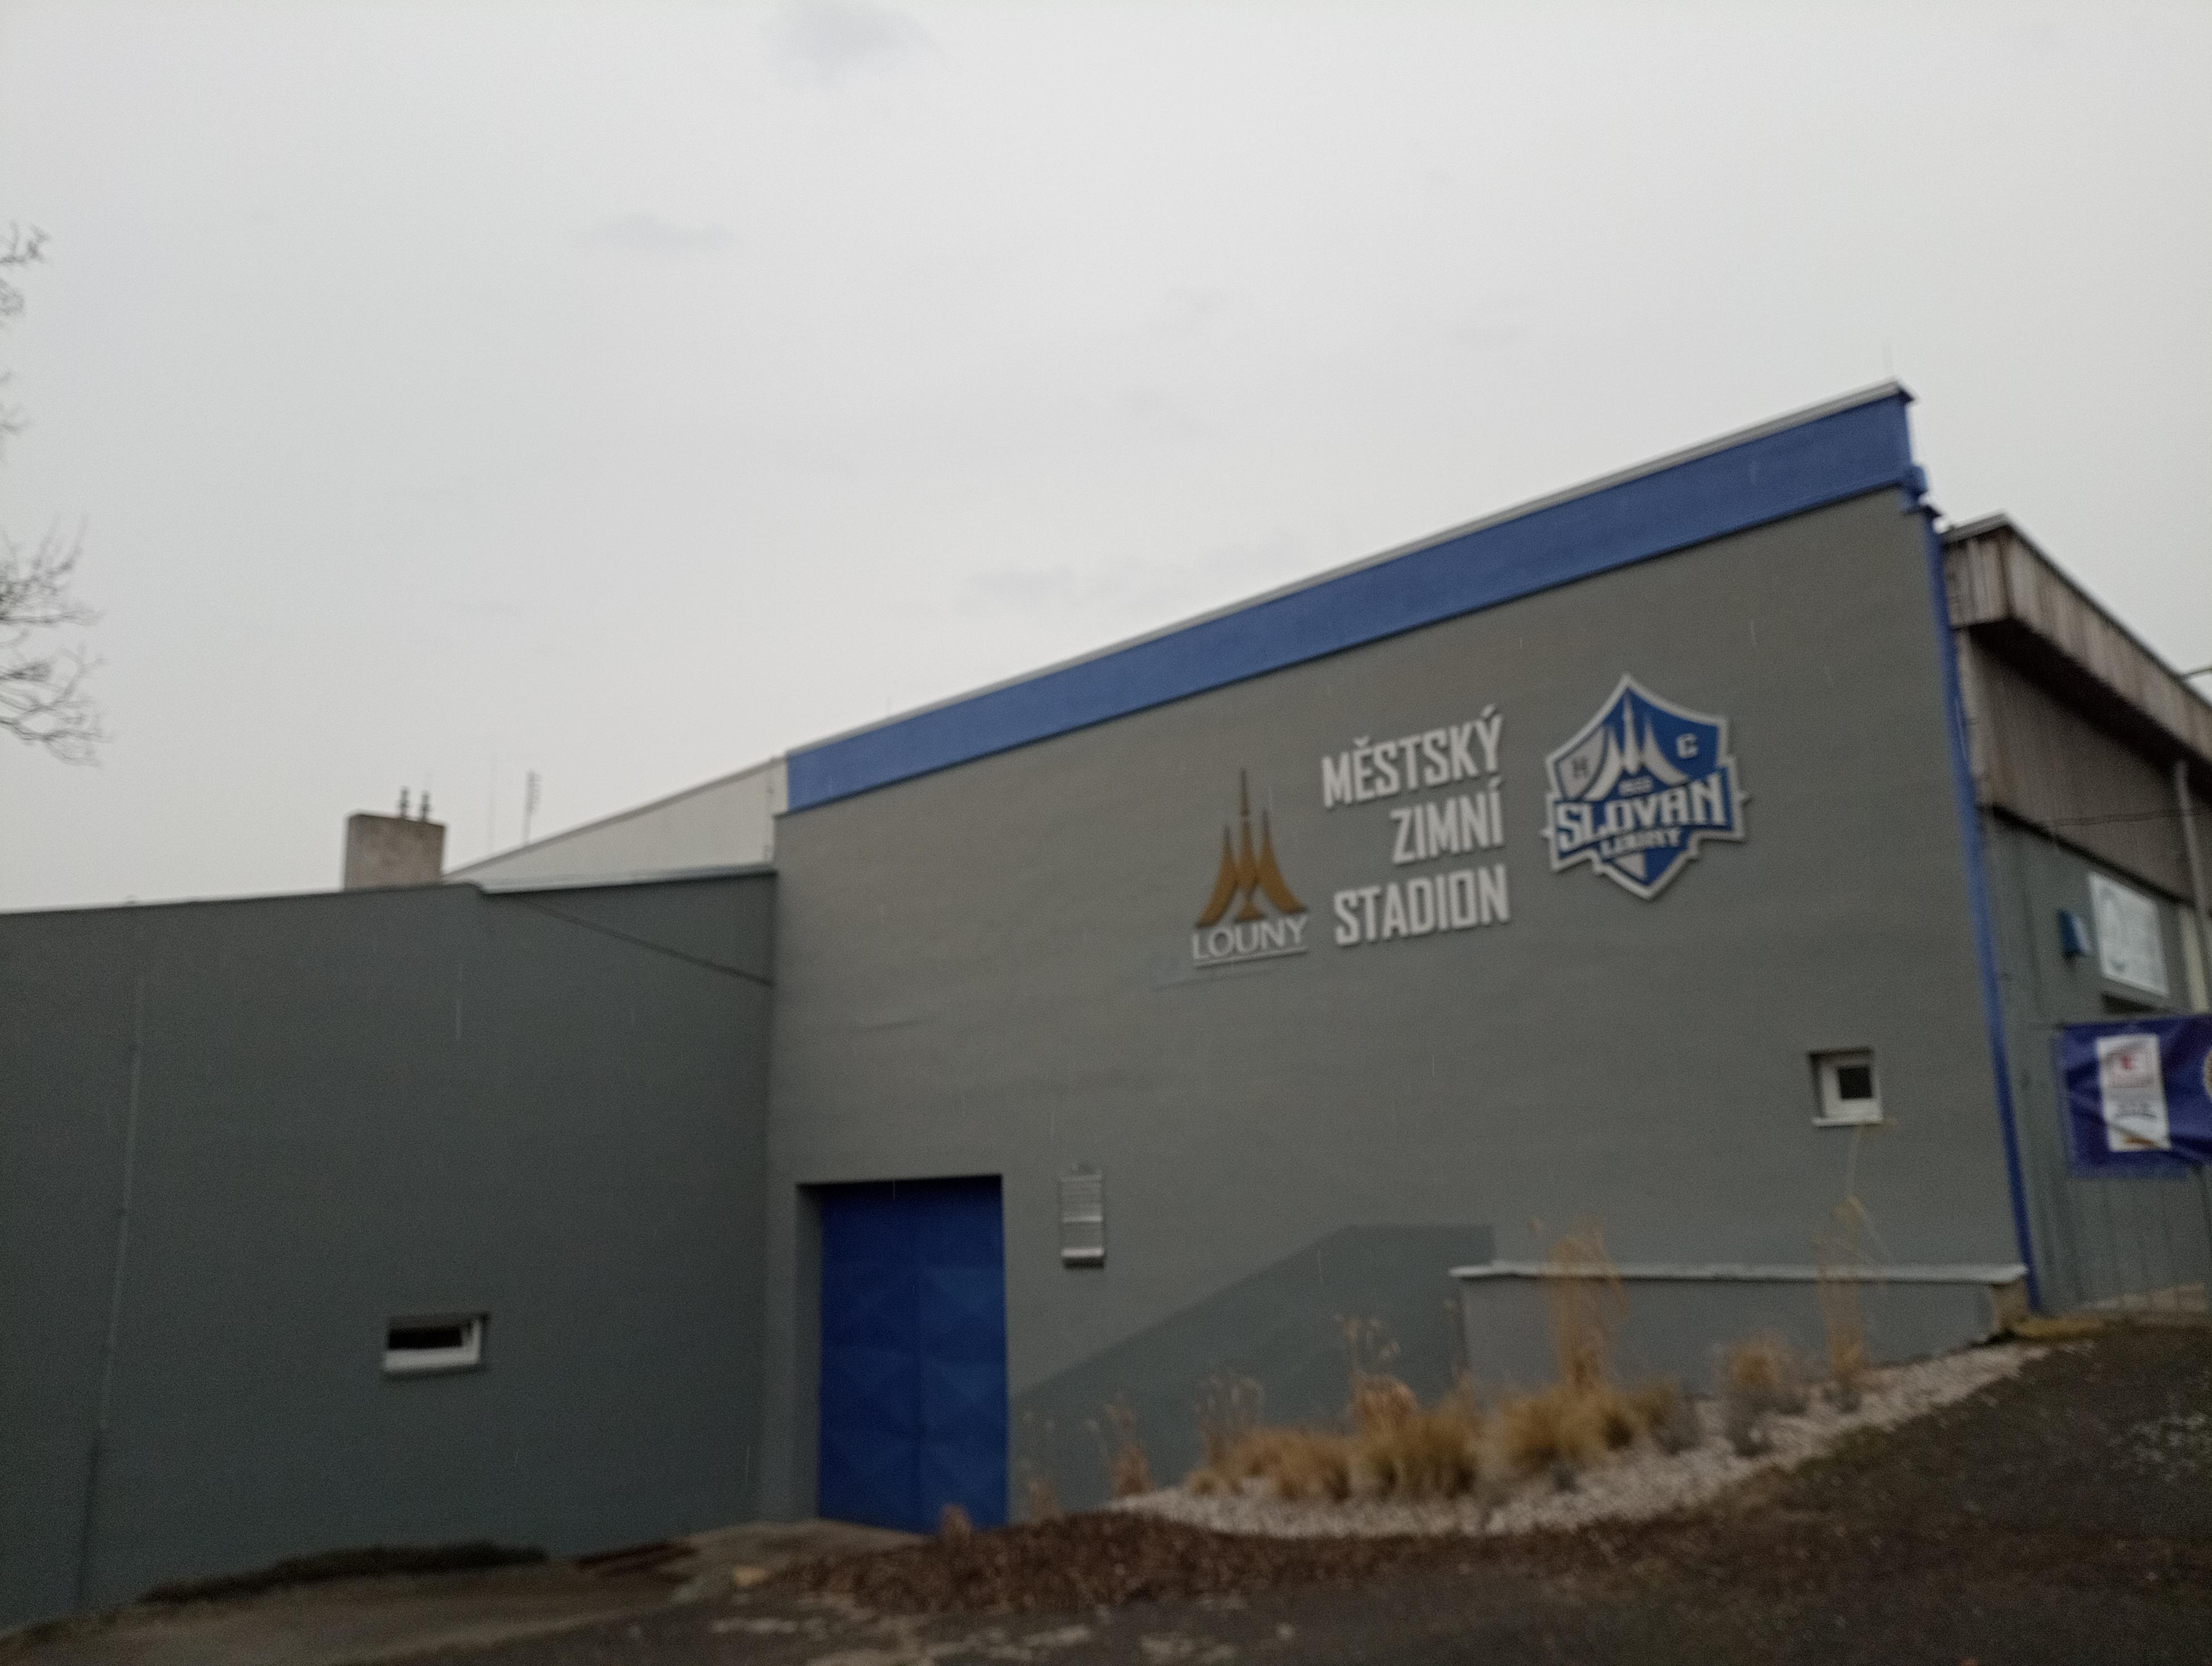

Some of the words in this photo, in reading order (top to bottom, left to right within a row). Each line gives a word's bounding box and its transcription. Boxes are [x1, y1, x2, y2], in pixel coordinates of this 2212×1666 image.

[1321, 704, 1502, 809] MĚSTSKÝ
[1390, 777, 1504, 864] ZIMNÍ
[1556, 771, 1726, 852] SLOVAN
[1192, 915, 1309, 960] LOUNY
[1334, 864, 1510, 945] STADION
